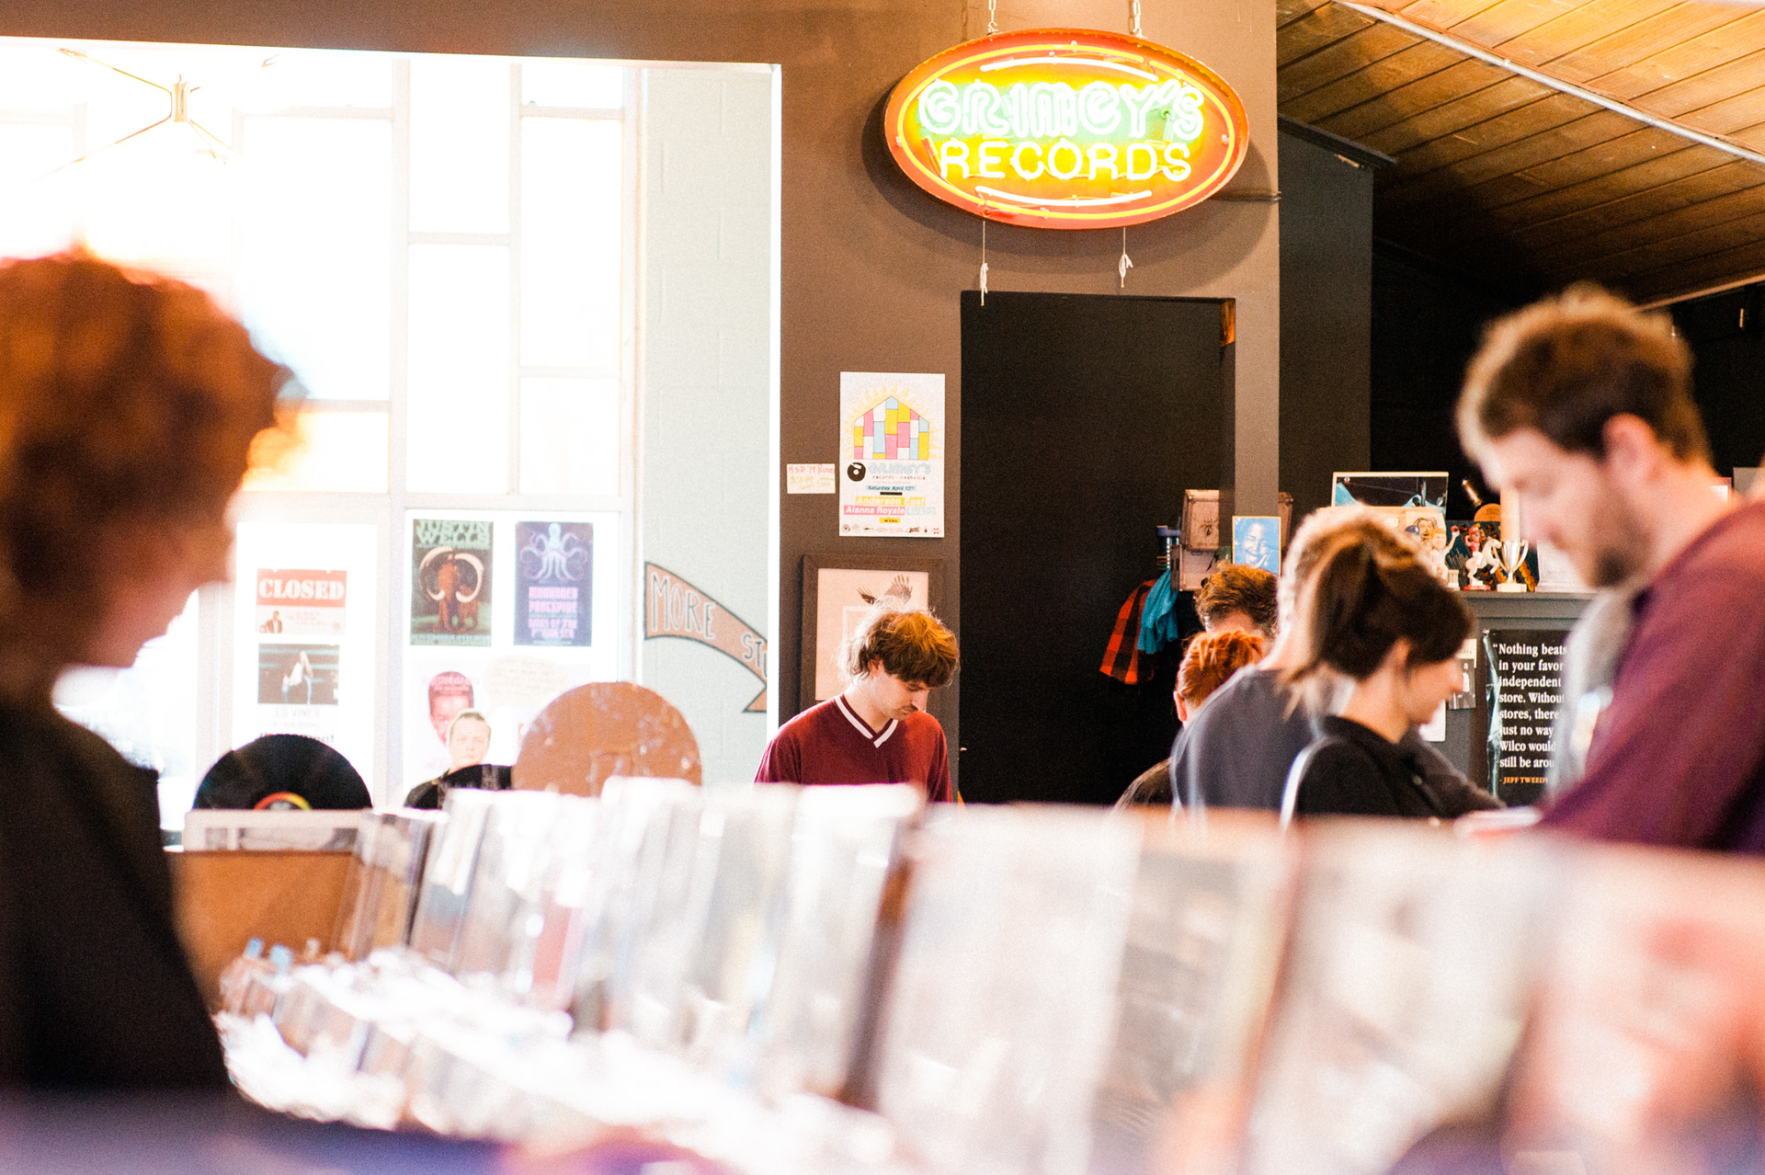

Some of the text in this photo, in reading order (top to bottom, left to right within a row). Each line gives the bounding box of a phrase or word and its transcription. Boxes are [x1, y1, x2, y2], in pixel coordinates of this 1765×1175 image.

[940, 140, 1191, 182] RECORDS
[846, 506, 875, 514] Alanna
[876, 506, 905, 515] Royale
[258, 579, 345, 600] CLOSED
[652, 573, 715, 639] MORE
[1498, 659, 1509, 671] in
[1511, 661, 1535, 673] your
[1499, 675, 1562, 690] independent
[1499, 693, 1526, 703] store.
[1499, 709, 1532, 721] stores,
[1499, 725, 1555, 739] ust no way
[1500, 740, 1526, 752] Wilco
[1499, 756, 1517, 768] still
[1519, 755, 1531, 768] be
